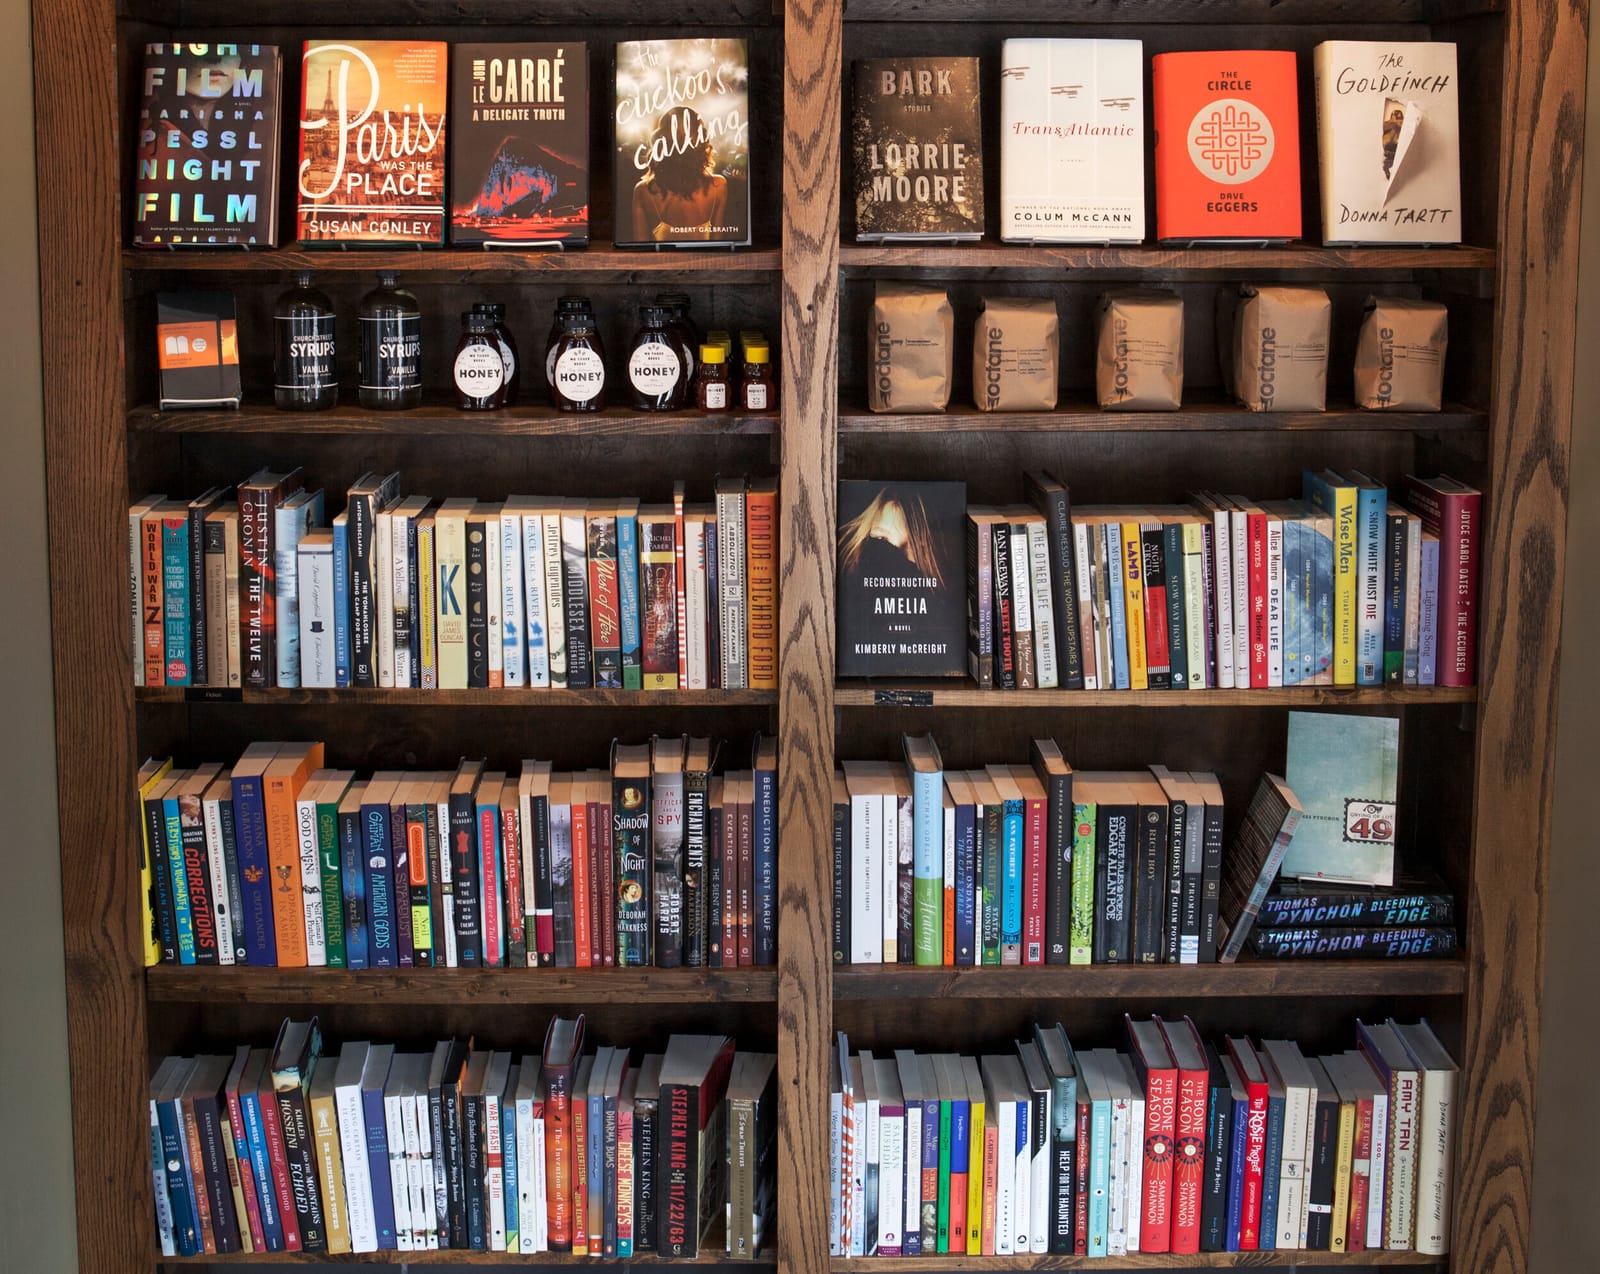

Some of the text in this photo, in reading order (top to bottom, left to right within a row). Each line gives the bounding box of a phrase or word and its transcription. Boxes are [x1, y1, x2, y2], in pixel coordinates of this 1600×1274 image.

[473, 60, 485, 81] JOHN
[473, 49, 565, 103] LE CARRÉ
[1378, 53, 1403, 68] The
[145, 68, 263, 97] FILM
[882, 70, 953, 95] BARK
[1208, 81, 1252, 91] CIRCLE
[141, 109, 264, 120] MARISHA
[299, 44, 445, 198] Paris
[473, 109, 565, 121] A DELICATE TRUTH
[141, 130, 262, 149] PESSL
[634, 109, 748, 169] calling
[140, 159, 260, 181] NIGHT
[381, 161, 432, 171] WAS THE
[871, 144, 966, 170] LORRIE
[347, 174, 432, 195] PLACE
[873, 175, 966, 201] MOORE
[137, 193, 257, 222] FILM
[1014, 213, 1131, 221] COLUM McCANN
[1207, 202, 1258, 212] EGGERS
[1339, 203, 1452, 226] DONNA TARTT
[309, 220, 431, 235] SUSAN CONLEY
[290, 341, 335, 358] SYRUPS
[379, 342, 420, 358] SYRUPS
[877, 321, 891, 391] octane
[986, 327, 1003, 399] octane
[1257, 327, 1276, 396] octane
[1378, 327, 1393, 395] octane
[302, 364, 328, 373] VANILLA
[391, 364, 415, 373] VANILLA
[459, 368, 501, 378] HONEY
[560, 371, 601, 382] HONEY
[634, 367, 676, 377] HONEY
[242, 501, 253, 567] CRONIN
[255, 503, 267, 567] JUSTIN
[1058, 501, 1066, 535] CLAIRE
[146, 523, 156, 571] WORLD
[1061, 535, 1069, 567] MESSUD
[1270, 530, 1281, 552] Alice
[1340, 504, 1353, 574] Wise Men
[547, 524, 561, 608] Jeffrey Eugenides
[997, 530, 1008, 596] IAN McEWAN
[1127, 540, 1140, 581] LAMB
[1270, 554, 1280, 580] Munro
[1365, 511, 1379, 620] SNOW WHITE MUST DIE
[147, 575, 158, 603] WAR
[567, 566, 584, 632] MIDDLESEX
[750, 504, 773, 682] CANADA RICHARD FORD
[864, 577, 937, 588] RECONSTRUCTING
[1456, 509, 1471, 673] JOYCE CAROL OATES THE ACCURSED
[146, 606, 161, 625] Z
[249, 577, 260, 662] THE TWELVE
[874, 597, 927, 615] AMELIA
[1065, 588, 1074, 622] WOMAN
[1271, 588, 1279, 621] DEAR
[855, 643, 947, 654] KIMBERLY McCREIGHT
[1002, 599, 1012, 671] SWEET TOOTH
[1067, 625, 1078, 664] UPSTAIRS
[368, 811, 383, 853] GAIMAN
[614, 813, 649, 831] SHADOW
[657, 815, 681, 824] SPY
[688, 793, 703, 868] ENCHANTMENTS
[1350, 818, 1393, 840] 49
[300, 807, 315, 876] GOOD OMENS
[632, 835, 640, 845] OF
[763, 777, 771, 931] BENEDICTION KENT HARUF
[1118, 816, 1126, 859] COMPLETE
[620, 852, 645, 874] NIGHT
[1106, 817, 1118, 921] EDGAR ALLAN POE
[183, 847, 215, 949] CORRECTIONS
[323, 874, 342, 945] NEVERWHERE
[371, 873, 390, 949] AMERICAN GODS
[619, 911, 646, 919] DEBORAH
[659, 894, 669, 934] HARRIS
[670, 893, 679, 934] ROBERT
[1116, 894, 1124, 921] POEMS
[1267, 896, 1424, 912] THOMAS BLEEDING
[1275, 903, 1430, 925] PYNCHON EDGE
[618, 923, 647, 932] HARKNESS
[1268, 929, 1425, 944] THOMAS BLEEDING
[1277, 934, 1432, 957] PYNCHON EDGE
[1149, 1078, 1162, 1132] SEASON
[1161, 1097, 1173, 1132] BONE
[1180, 1080, 1194, 1133] SEASON
[1192, 1081, 1204, 1133] THE BONE
[1400, 1079, 1412, 1151] AMY TAN
[280, 1099, 298, 1149] HOSSEINI
[489, 1104, 499, 1151] WAR TRASH
[671, 1088, 688, 1169] STEPHEN KING
[290, 1163, 308, 1214] ECHOED
[306, 1176, 320, 1224] MOUNTAINS
[617, 1142, 632, 1225] CHEESE MONKEYS
[1057, 1150, 1070, 1235] HELP FOR THE HAUNTED
[669, 1183, 686, 1244] 11/22/63
[1148, 1179, 1157, 1225] SHANNON
[1156, 1180, 1166, 1225] SAMANTHA
[1178, 1181, 1188, 1227] SHANNON
[1187, 1181, 1197, 1227] SAMANTHA
